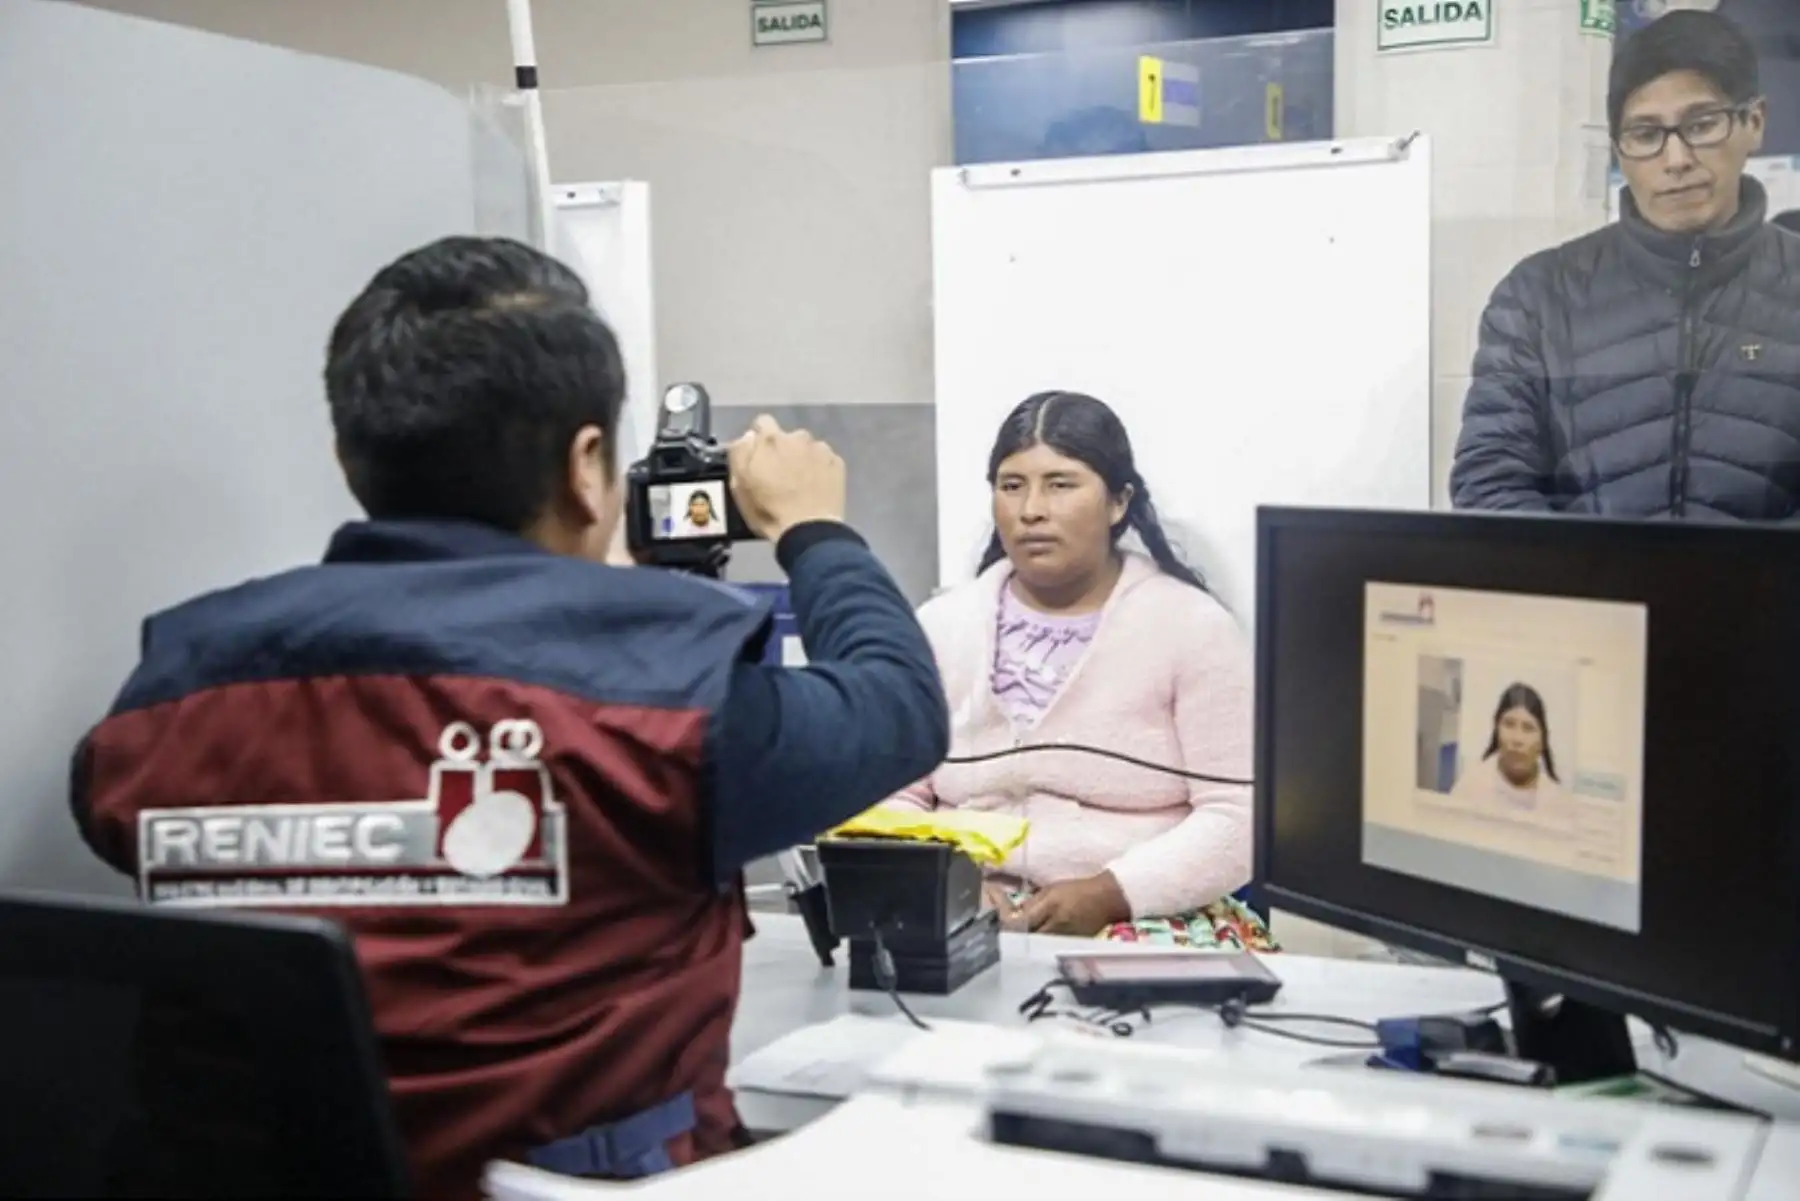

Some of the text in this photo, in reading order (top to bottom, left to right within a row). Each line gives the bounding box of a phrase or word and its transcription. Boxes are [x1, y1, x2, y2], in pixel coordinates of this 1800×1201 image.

[757, 13, 821, 33] SALIDA
[1383, 2, 1484, 29] SALIDA
[152, 814, 404, 865] RENIEC
